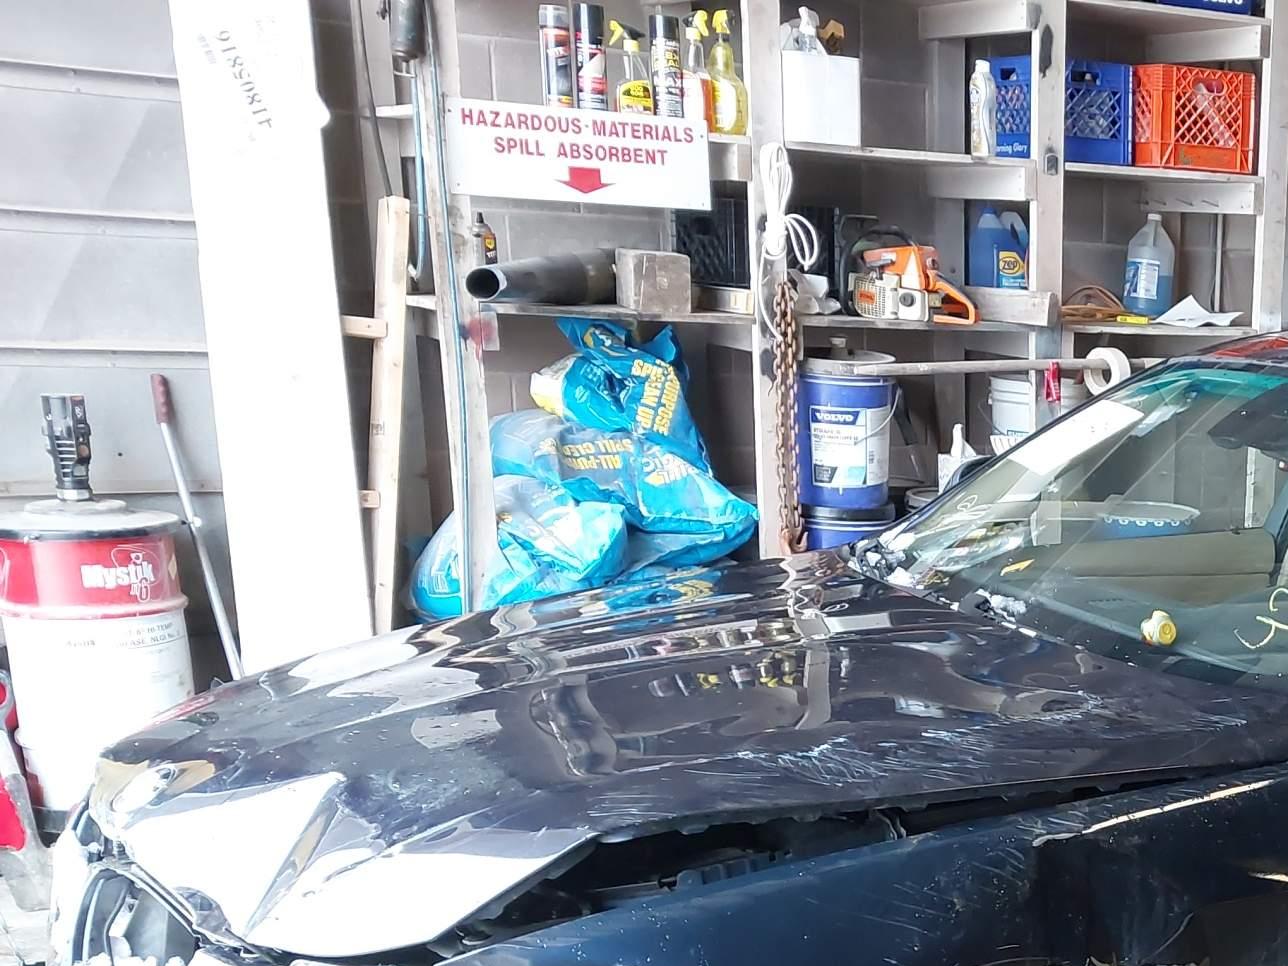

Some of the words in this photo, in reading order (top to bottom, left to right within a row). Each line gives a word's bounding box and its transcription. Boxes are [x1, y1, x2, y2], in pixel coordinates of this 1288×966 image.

[461, 107, 583, 135] HAZARDOUS
[592, 119, 694, 144] MATERIALS
[494, 136, 545, 157] SPILL
[556, 142, 668, 166] ABSORBENT
[815, 412, 854, 422] VOLVO
[80, 552, 155, 590] Mystik
